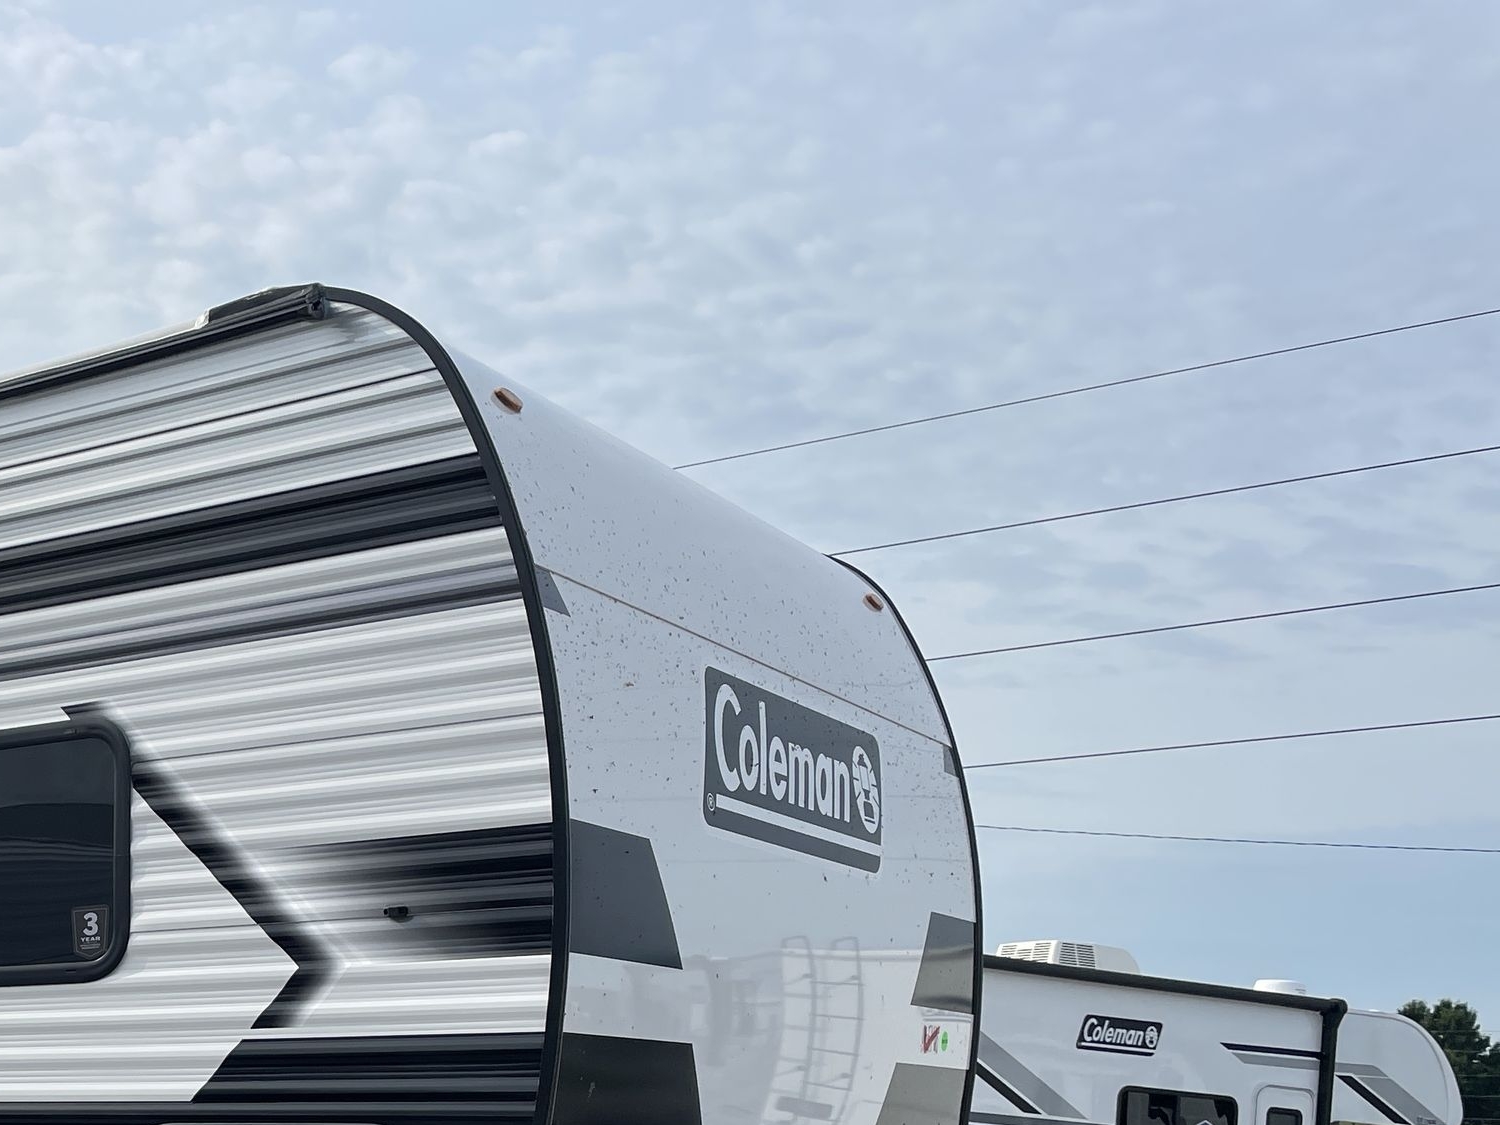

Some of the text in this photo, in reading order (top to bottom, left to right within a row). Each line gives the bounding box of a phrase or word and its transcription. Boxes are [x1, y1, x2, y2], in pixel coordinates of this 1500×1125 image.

[714, 683, 850, 823] Coleman
[83, 912, 98, 936] 3
[1083, 1017, 1145, 1046] Coleman
